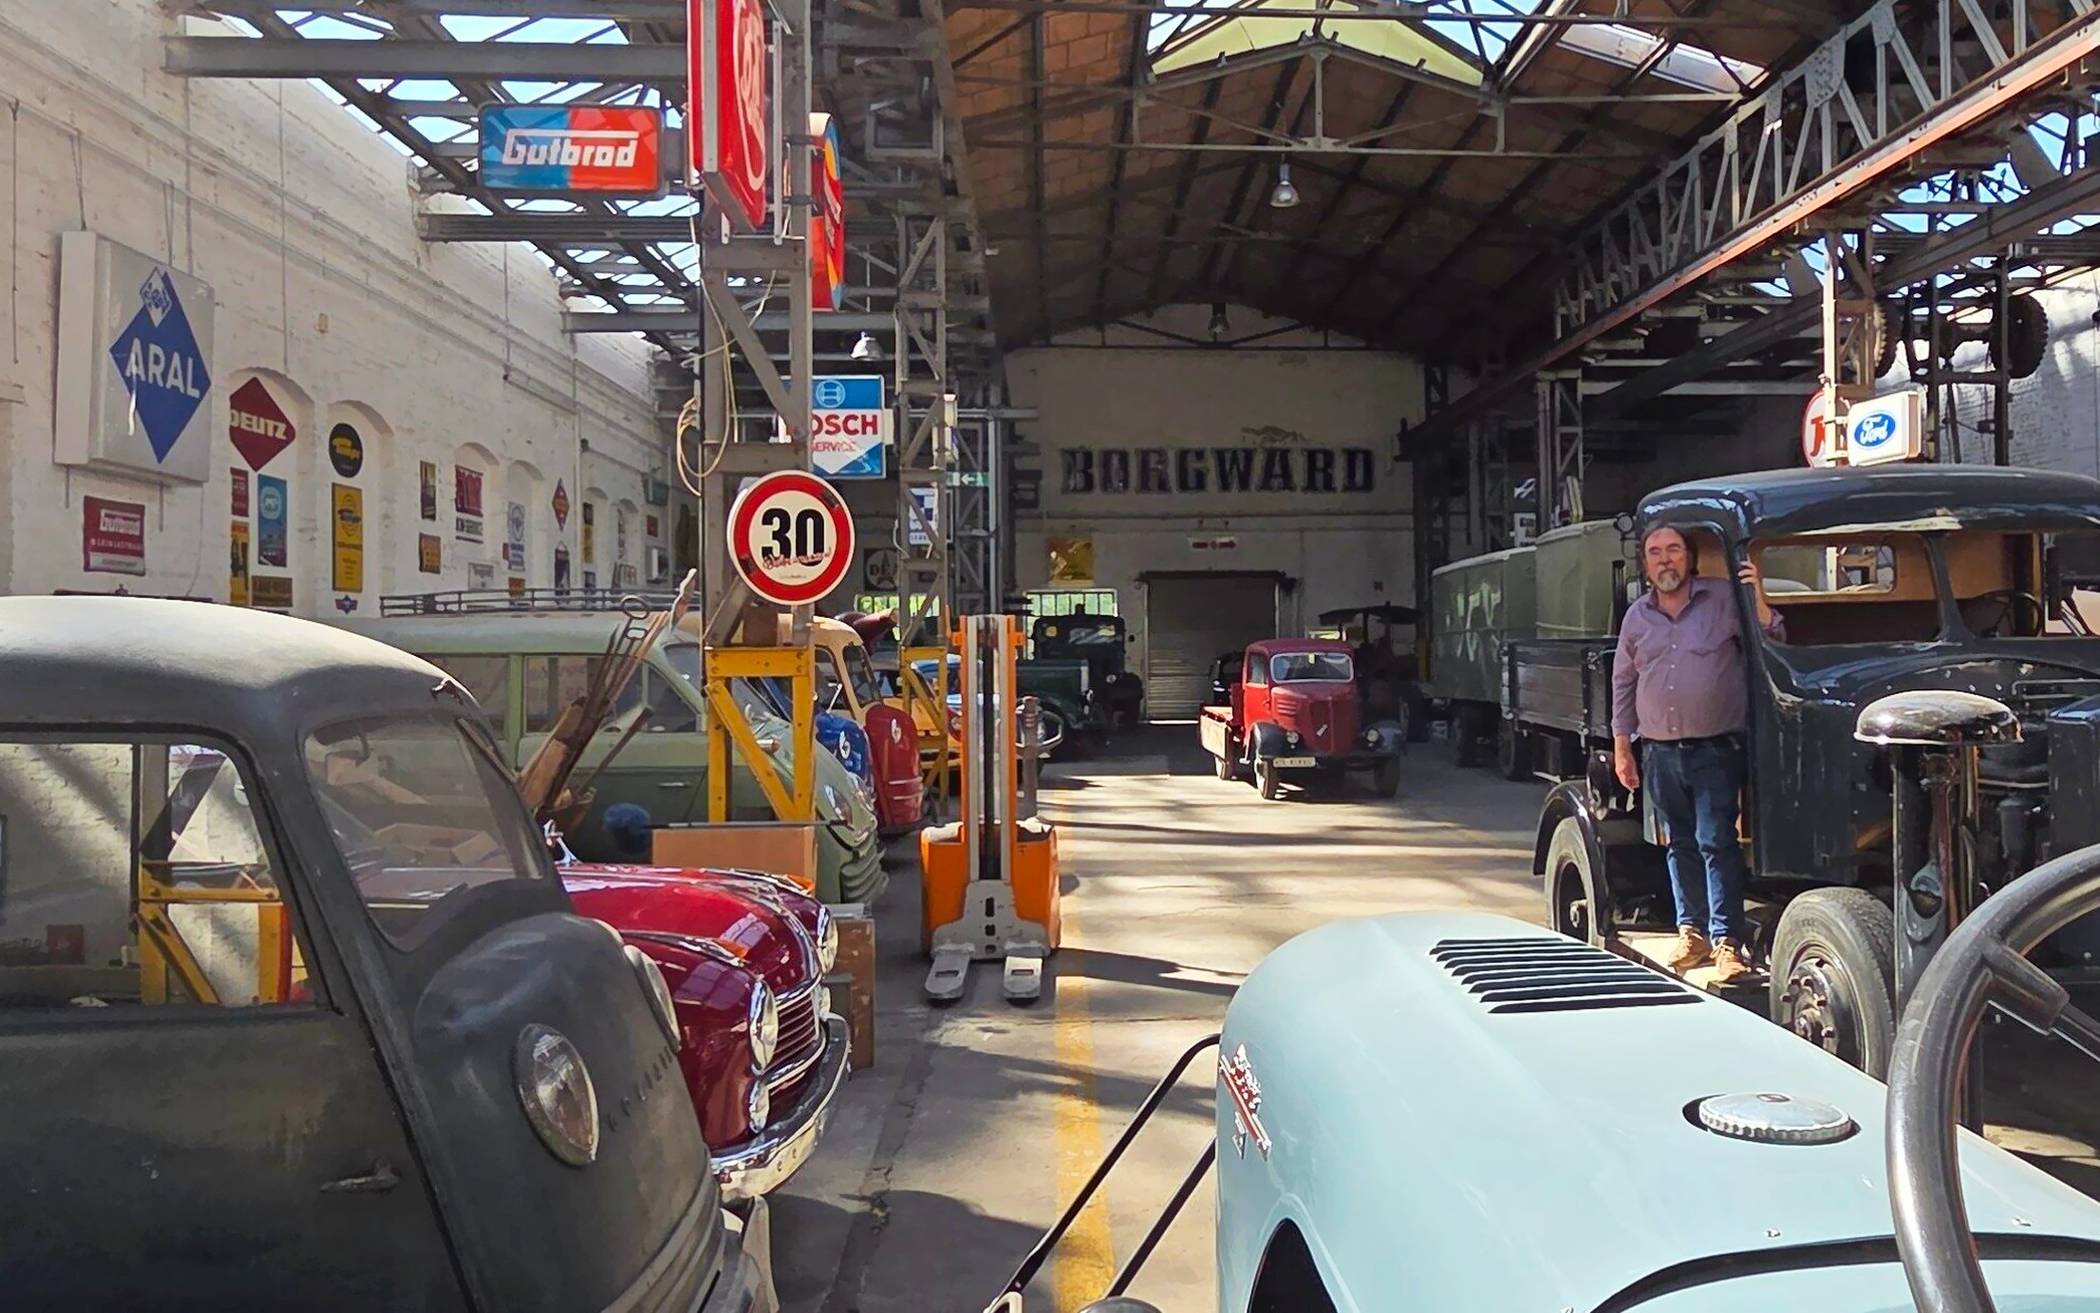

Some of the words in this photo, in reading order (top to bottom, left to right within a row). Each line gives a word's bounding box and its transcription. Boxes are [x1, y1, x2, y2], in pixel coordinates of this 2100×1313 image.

[503, 128, 640, 168] Gutbrod
[125, 337, 200, 399] ARAL
[230, 408, 288, 441] DEUTZ
[811, 413, 878, 436] OSCH
[1861, 414, 1889, 445] Ford
[1061, 447, 1375, 494] BORGWARD
[761, 507, 825, 567] 30
